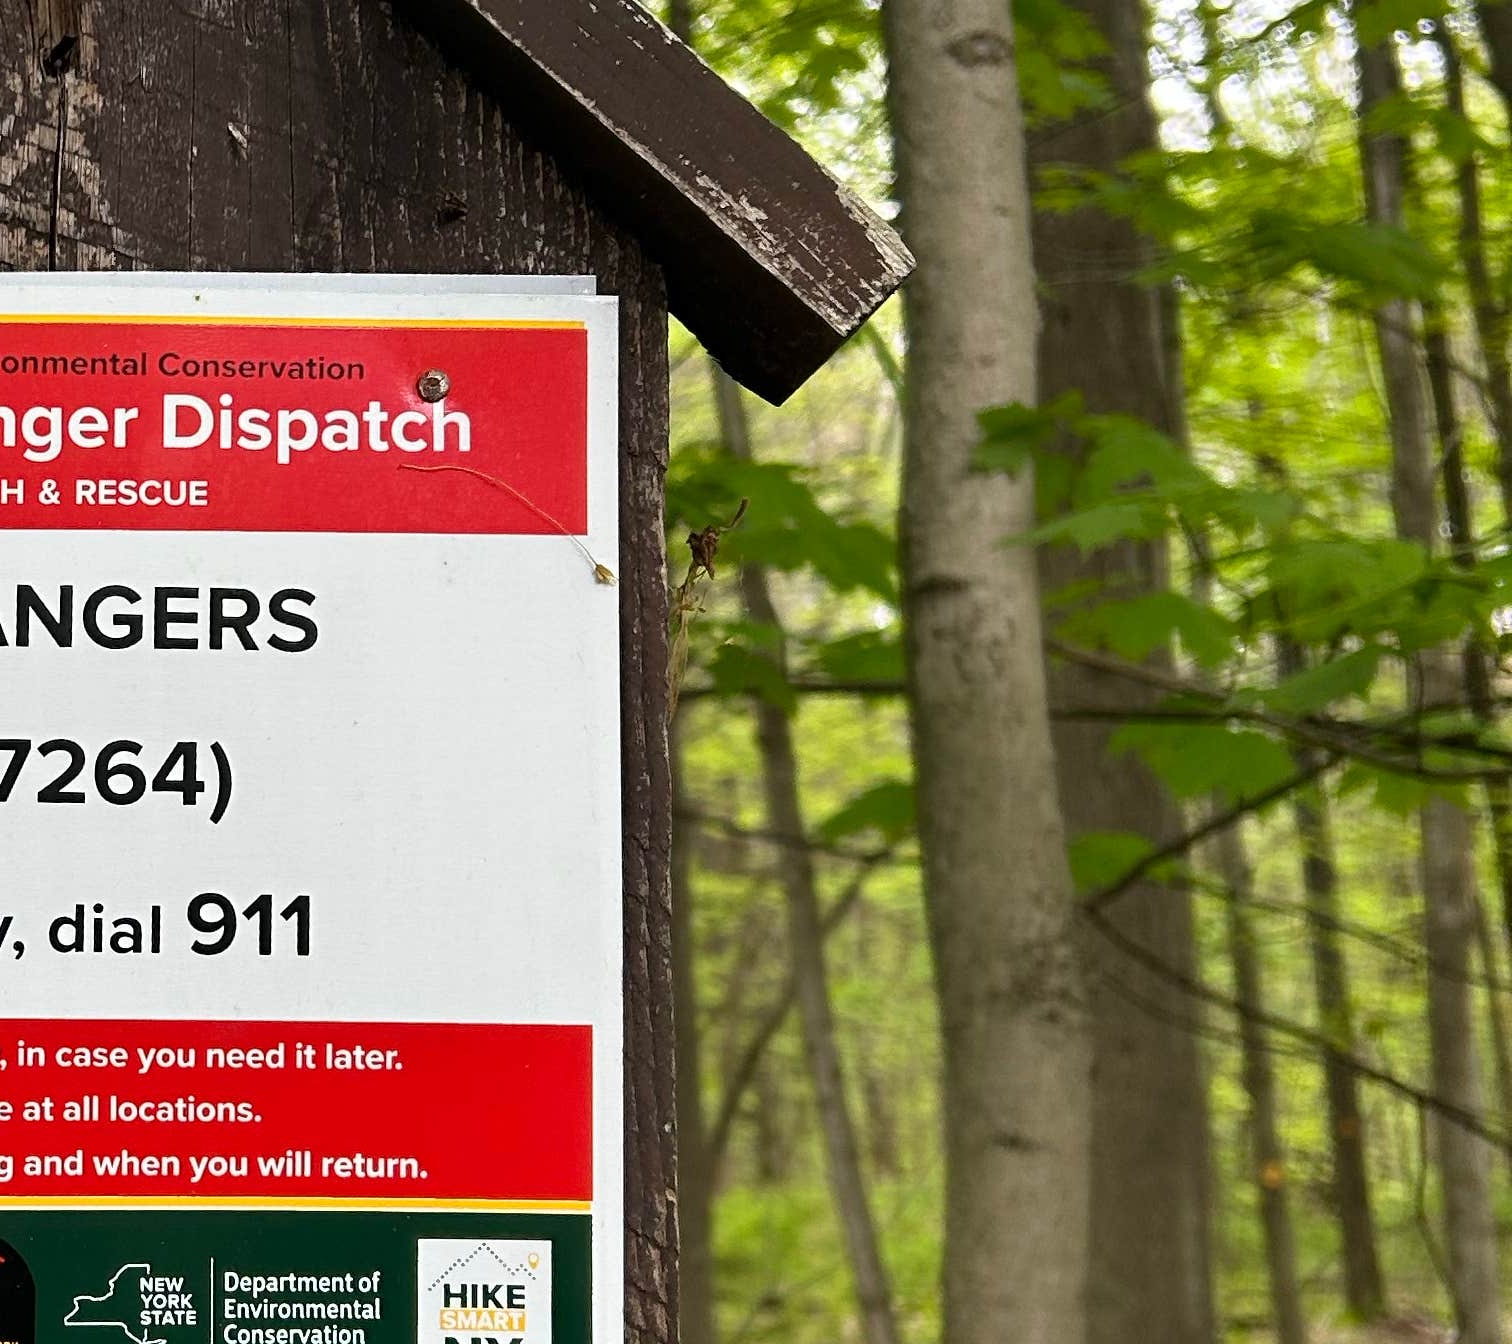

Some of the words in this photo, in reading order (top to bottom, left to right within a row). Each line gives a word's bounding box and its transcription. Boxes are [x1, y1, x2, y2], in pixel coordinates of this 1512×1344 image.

[158, 352, 365, 380] Conservation
[162, 395, 472, 463] Dispatch
[38, 478, 61, 505] &
[75, 479, 208, 506] RESCUE
[48, 902, 161, 954] dial
[186, 892, 311, 957] 911
[17, 1039, 46, 1067] in
[55, 1047, 129, 1068] case
[136, 1047, 196, 1074] you
[206, 1042, 285, 1069] need
[295, 1042, 317, 1070] it
[325, 1042, 403, 1070] later.
[22, 1096, 55, 1122] at
[62, 1095, 99, 1122] all
[110, 1095, 262, 1123] locations.
[23, 1149, 84, 1176] and
[92, 1149, 180, 1177] when
[188, 1156, 248, 1183] you
[257, 1149, 311, 1178] will
[321, 1152, 428, 1179] return.
[139, 1276, 184, 1293] NEW
[224, 1271, 354, 1301] Department
[358, 1270, 381, 1293] of
[442, 1284, 526, 1310] HIKE
[140, 1289, 193, 1312] YORK
[224, 1294, 381, 1320] Environmental
[139, 1305, 197, 1326] STATE
[442, 1312, 524, 1330] SMART
[223, 1323, 366, 1344] Conservation
